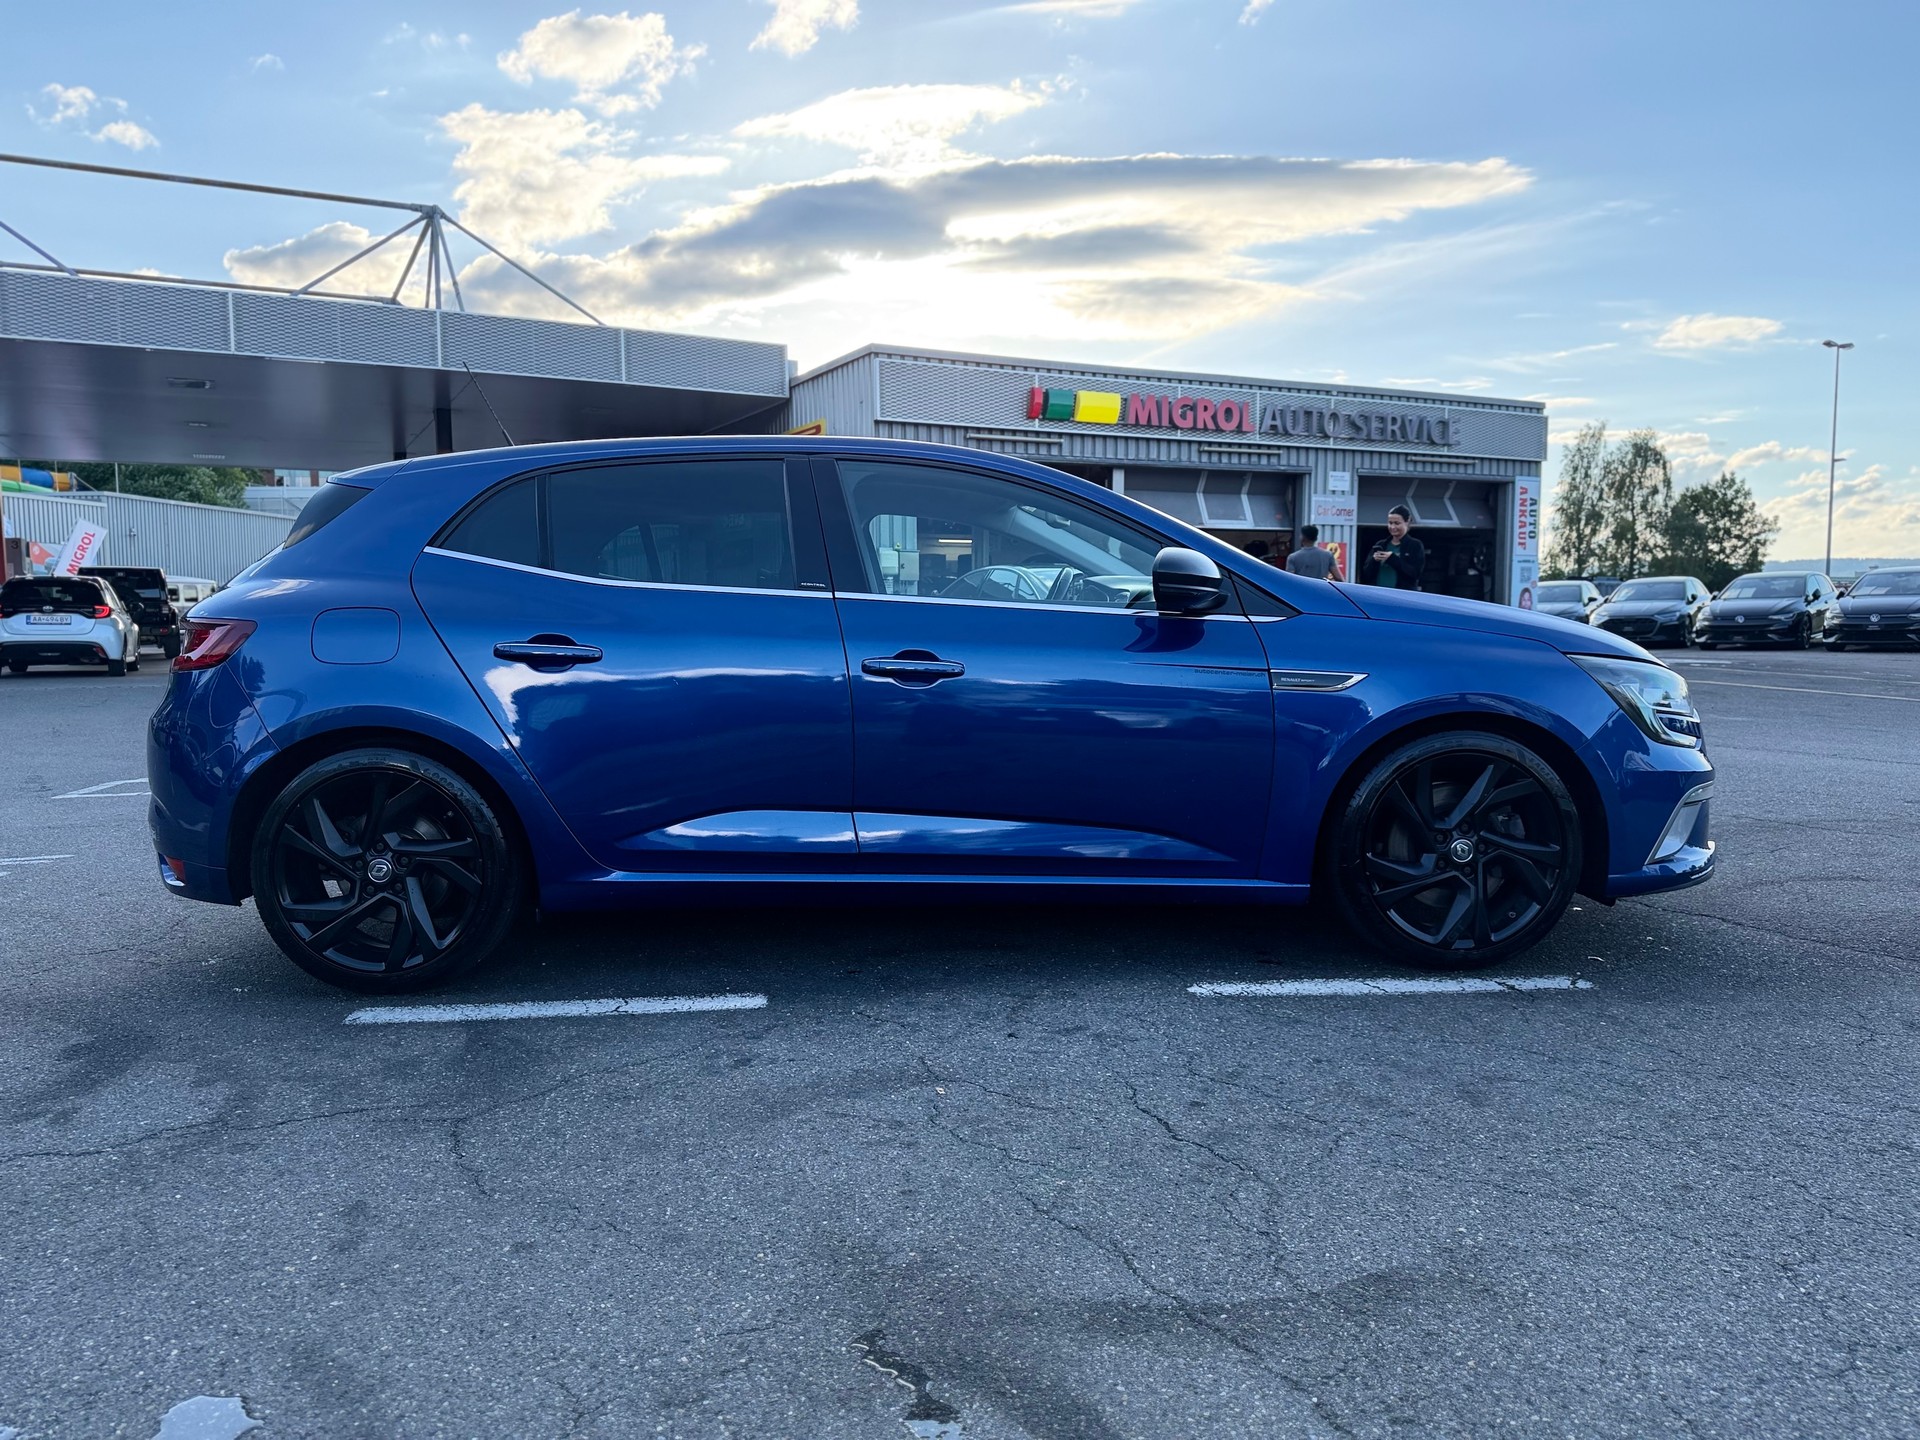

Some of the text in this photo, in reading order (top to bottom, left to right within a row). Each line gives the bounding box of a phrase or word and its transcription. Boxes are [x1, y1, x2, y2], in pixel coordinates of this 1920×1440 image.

[1127, 393, 1461, 446] MIGROL AUTO SERVICE
[1518, 486, 1528, 550] ANKAUF
[1528, 497, 1537, 539] AUTO
[11, 541, 19, 550] 3
[66, 531, 95, 576] MIGROL
